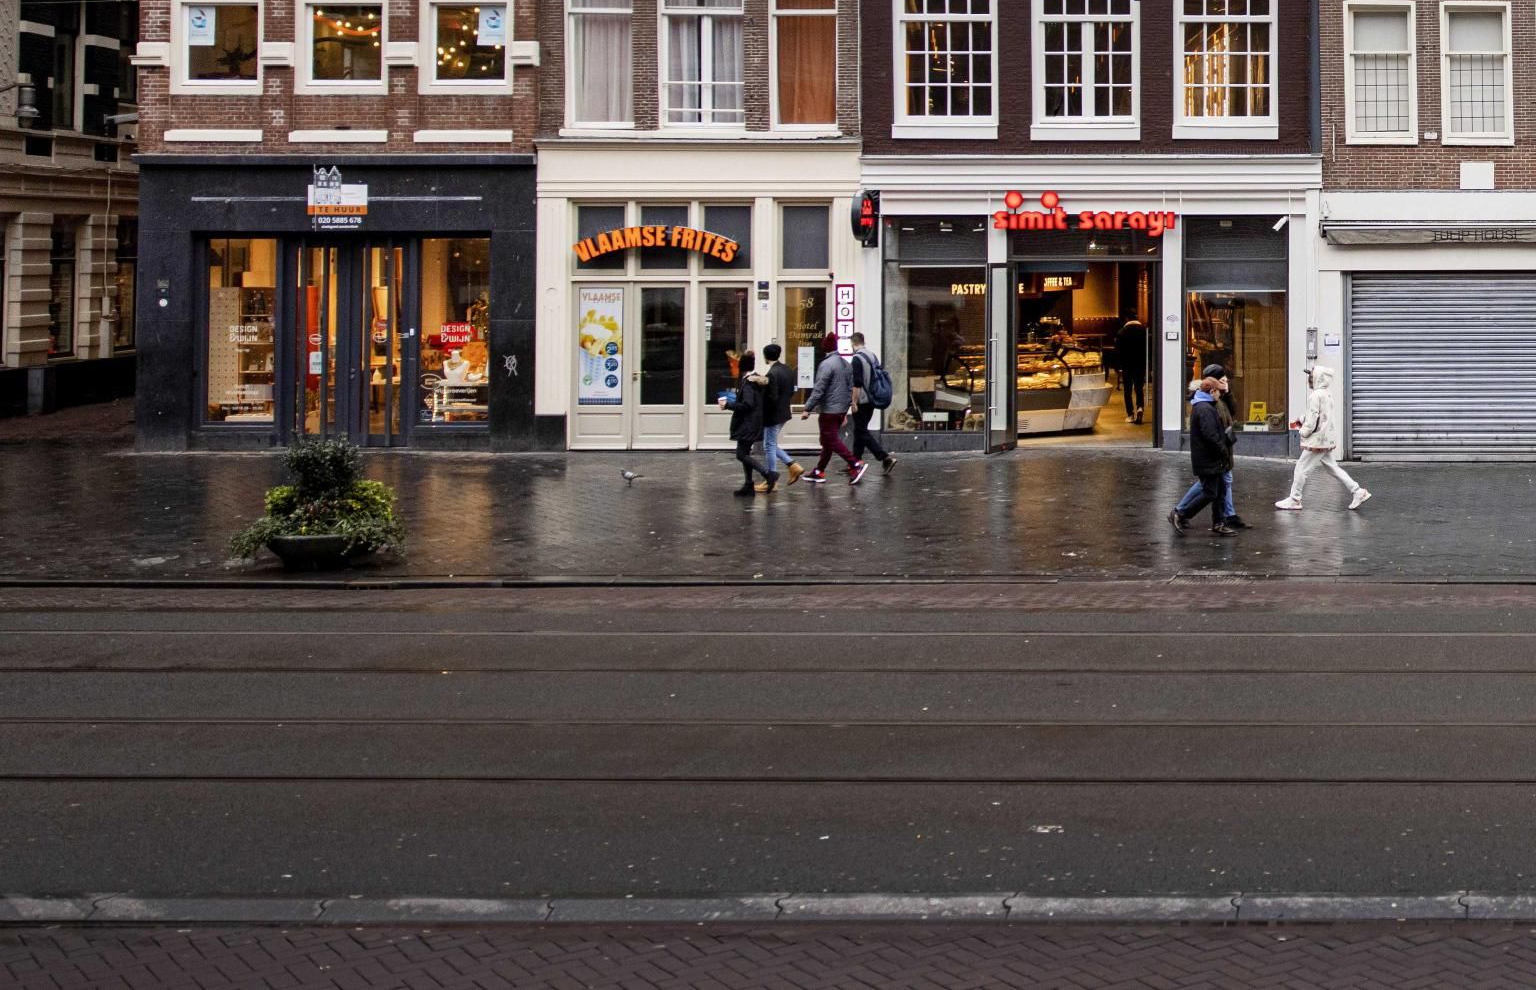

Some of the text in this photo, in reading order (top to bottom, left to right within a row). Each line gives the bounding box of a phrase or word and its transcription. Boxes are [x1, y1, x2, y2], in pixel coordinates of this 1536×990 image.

[993, 191, 1068, 230] simit
[572, 226, 738, 263] VLAAMSE FRITES
[951, 283, 987, 295] PASTRY
[800, 297, 814, 309] 58
[229, 325, 258, 333] DESIGN
[440, 325, 471, 333] DESIGN
[793, 321, 818, 331] Hotel
[787, 331, 823, 339] Damrak
